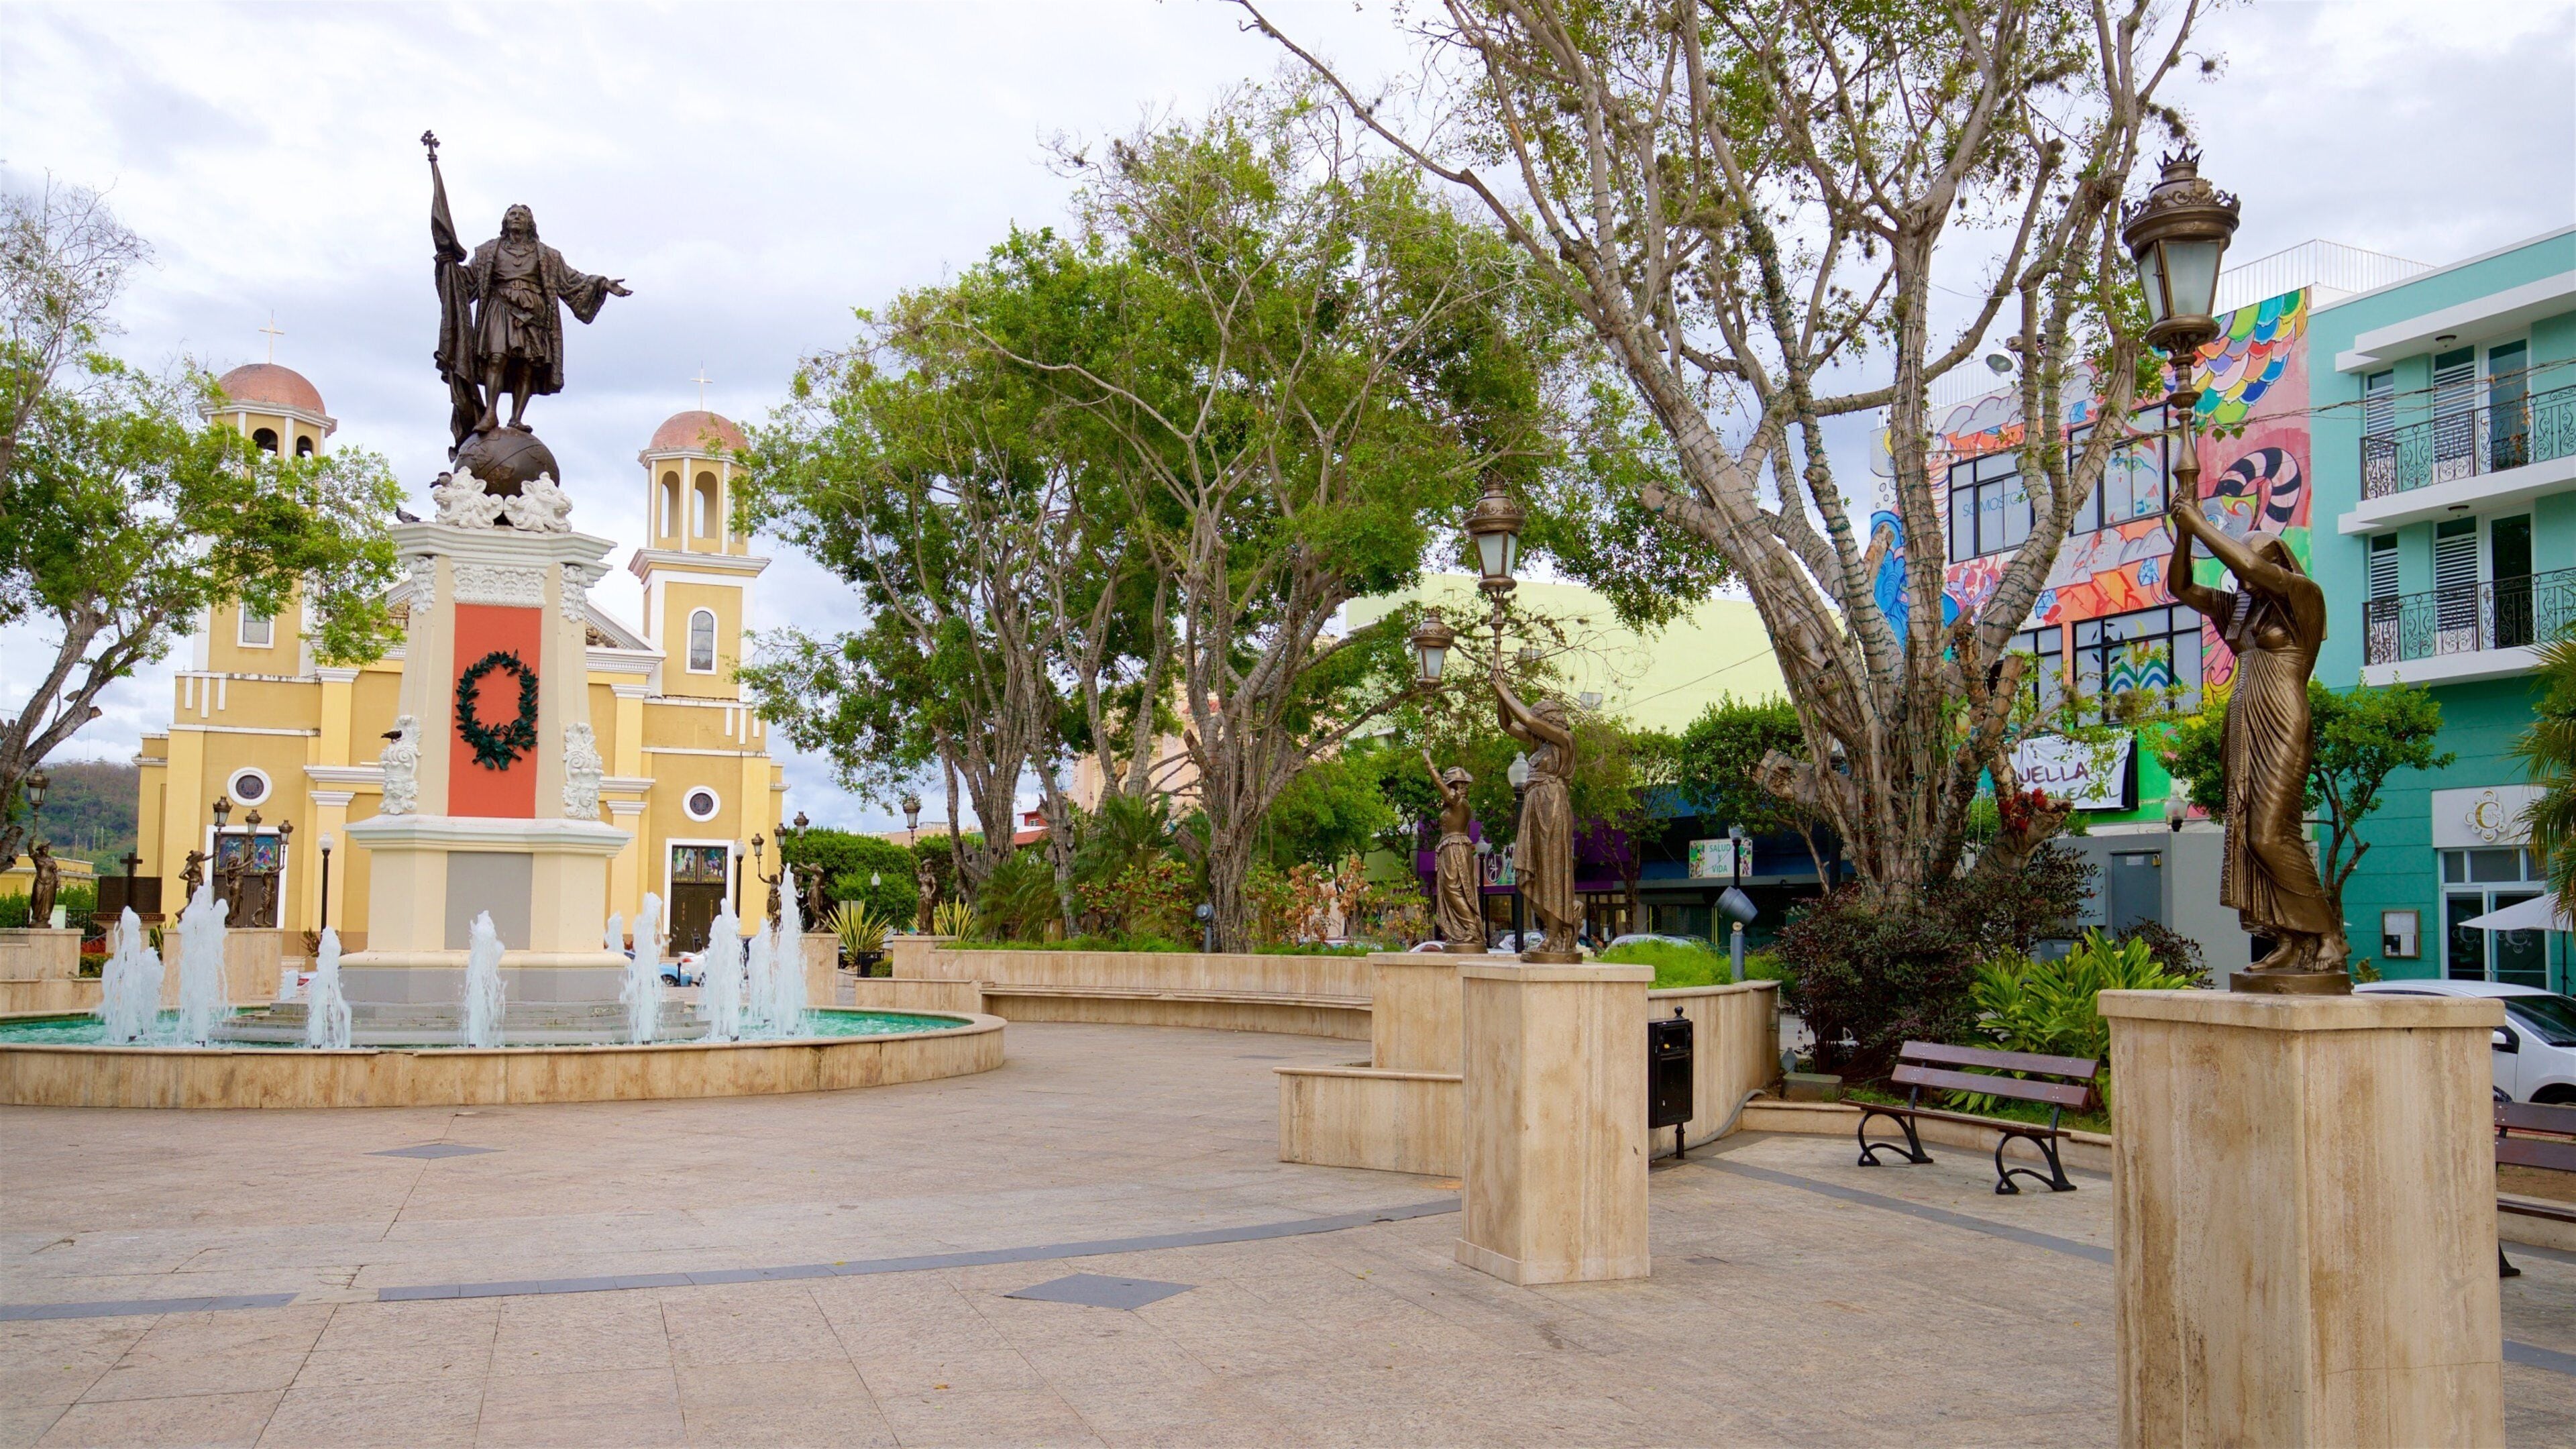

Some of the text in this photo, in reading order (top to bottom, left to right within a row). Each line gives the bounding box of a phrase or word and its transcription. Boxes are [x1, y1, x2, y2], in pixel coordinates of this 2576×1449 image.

[1962, 490, 2028, 517] SOMOSTO
[2018, 761, 2090, 784] UELLA
[1709, 845, 1731, 853] SALUD
[1712, 865, 1728, 873] VIDA
